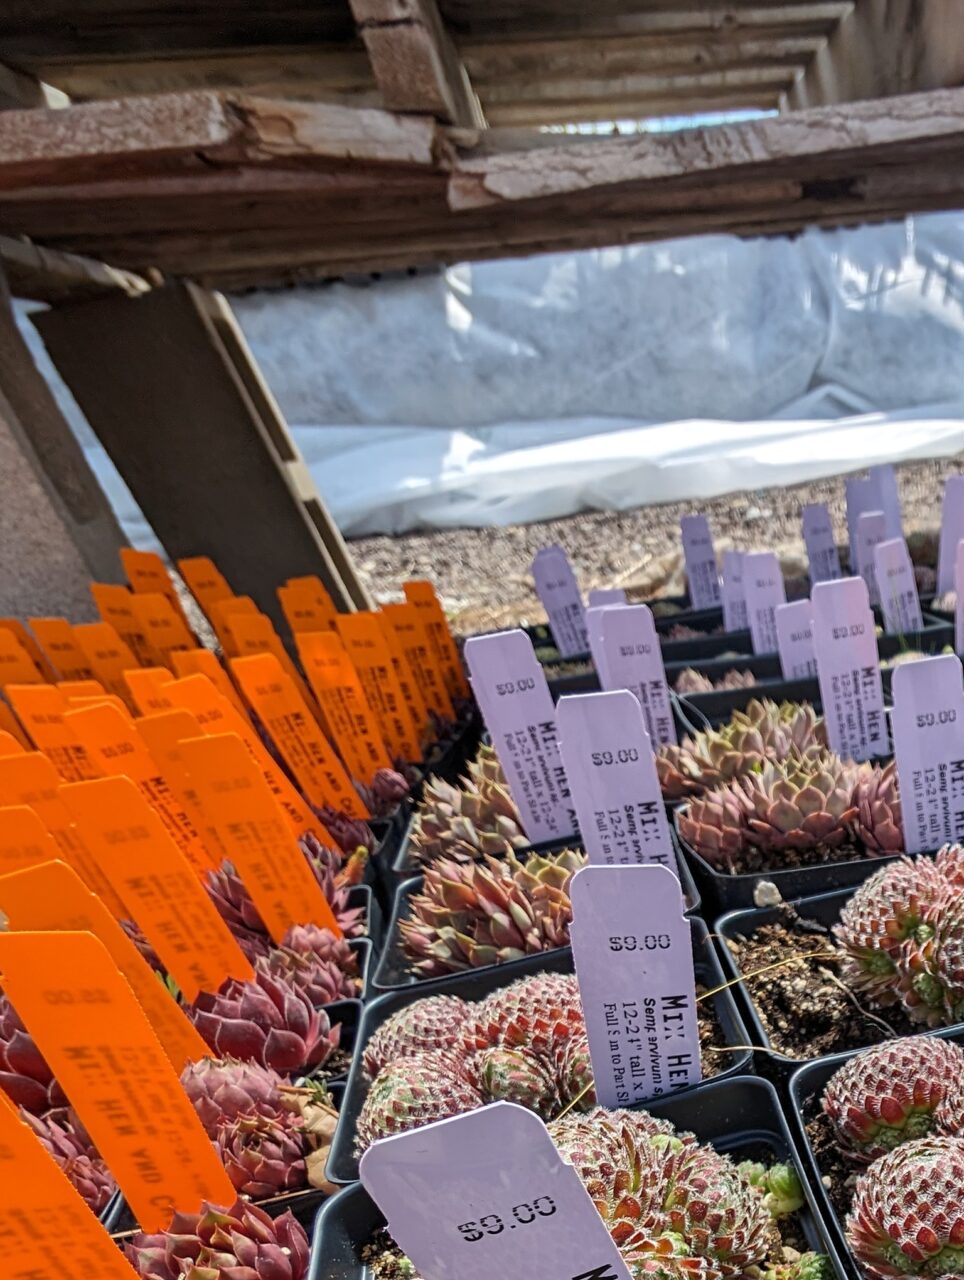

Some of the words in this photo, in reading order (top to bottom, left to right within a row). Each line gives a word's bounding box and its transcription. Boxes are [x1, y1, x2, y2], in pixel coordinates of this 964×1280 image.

[867, 711, 880, 742] HEN
[591, 747, 640, 768] $9.00
[594, 811, 608, 832] Full
[930, 814, 941, 833] tall
[609, 934, 671, 952] $9.00
[604, 1003, 619, 1026] Full
[611, 1054, 621, 1065] to
[629, 1055, 646, 1078] tall
[613, 1067, 625, 1089] Part
[633, 1082, 643, 1091] x
[456, 1195, 558, 1243] $9.00
